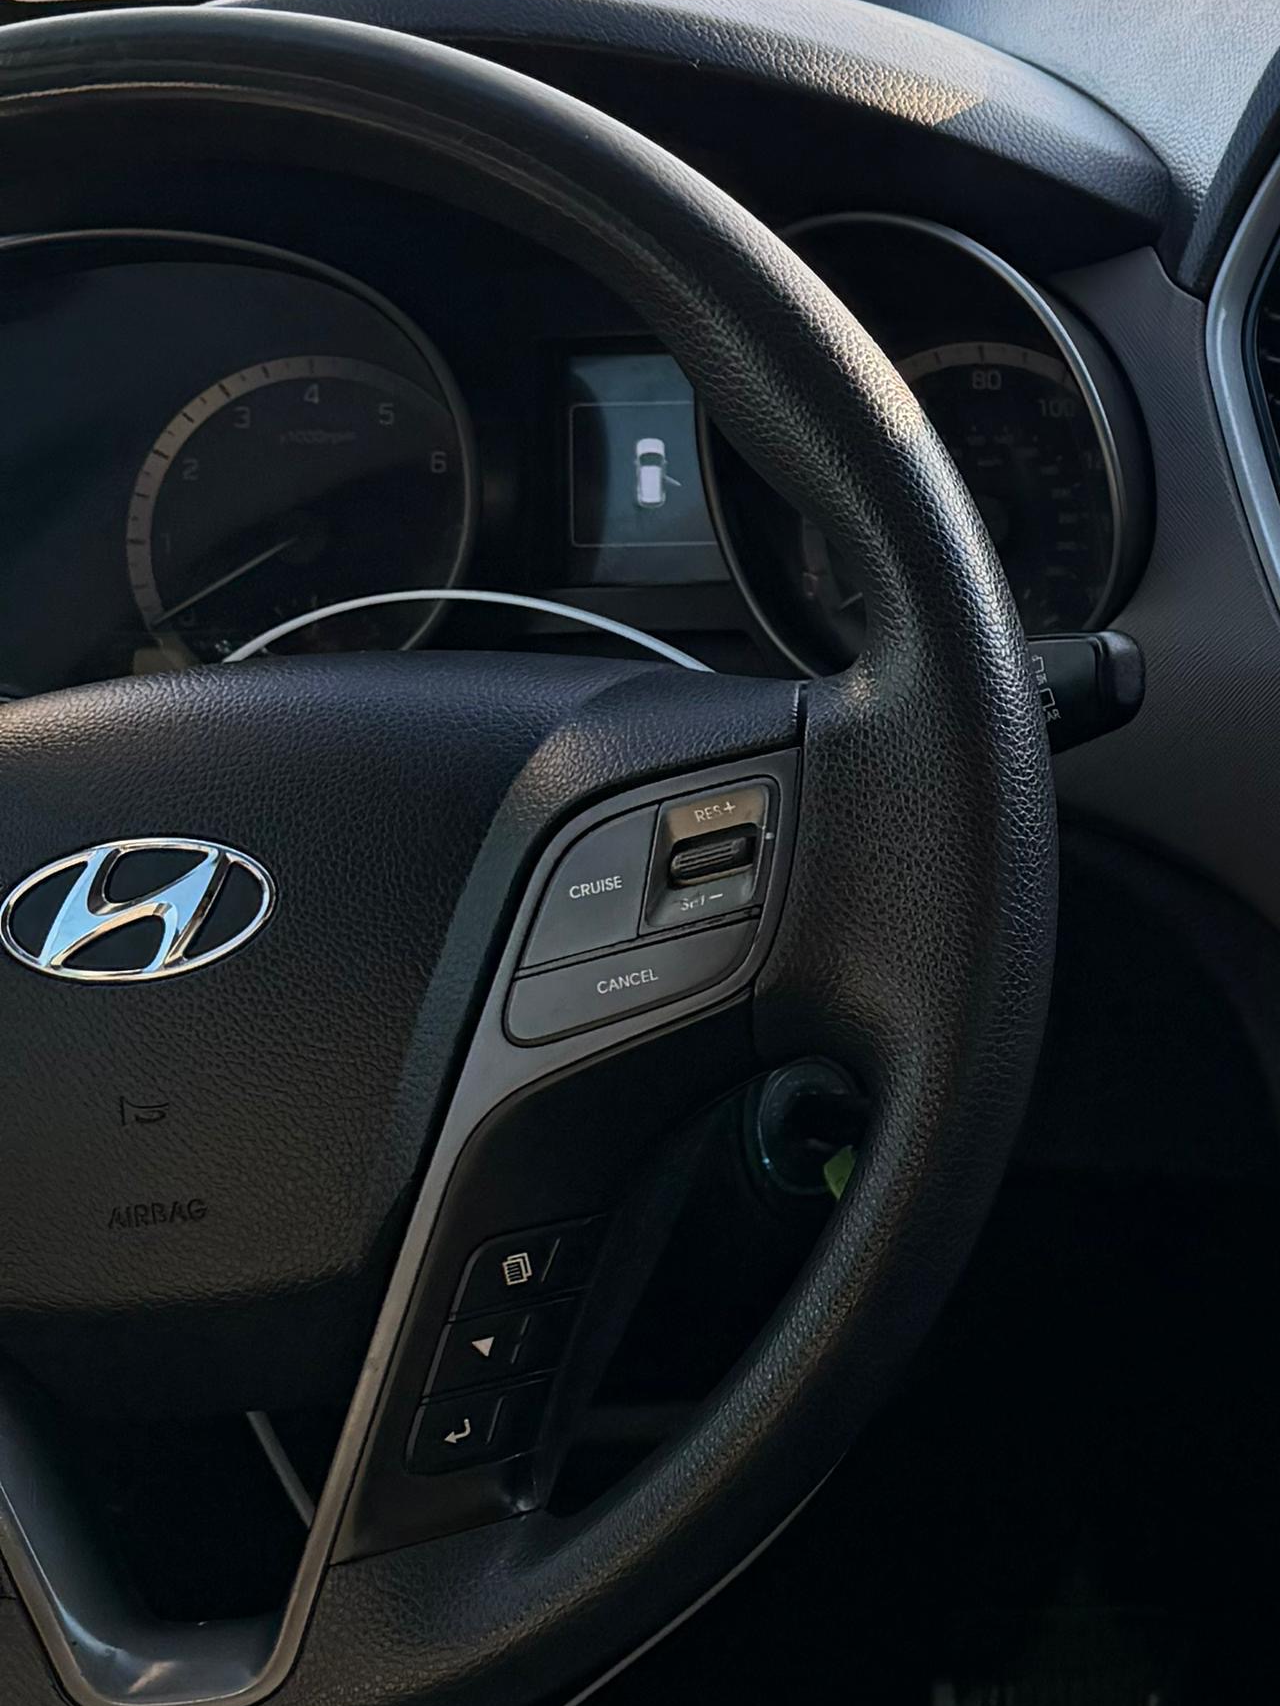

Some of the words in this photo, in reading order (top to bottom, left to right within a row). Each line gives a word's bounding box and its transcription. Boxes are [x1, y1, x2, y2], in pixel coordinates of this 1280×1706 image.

[971, 369, 1002, 391] 80
[303, 383, 320, 405] 4
[234, 405, 251, 429] 3
[378, 402, 395, 426] 5
[182, 457, 199, 481] 2
[430, 450, 447, 473] 6
[568, 875, 622, 899] CRUISE
[596, 968, 659, 995] CANCEL
[107, 1199, 208, 1229] AIRBAG
